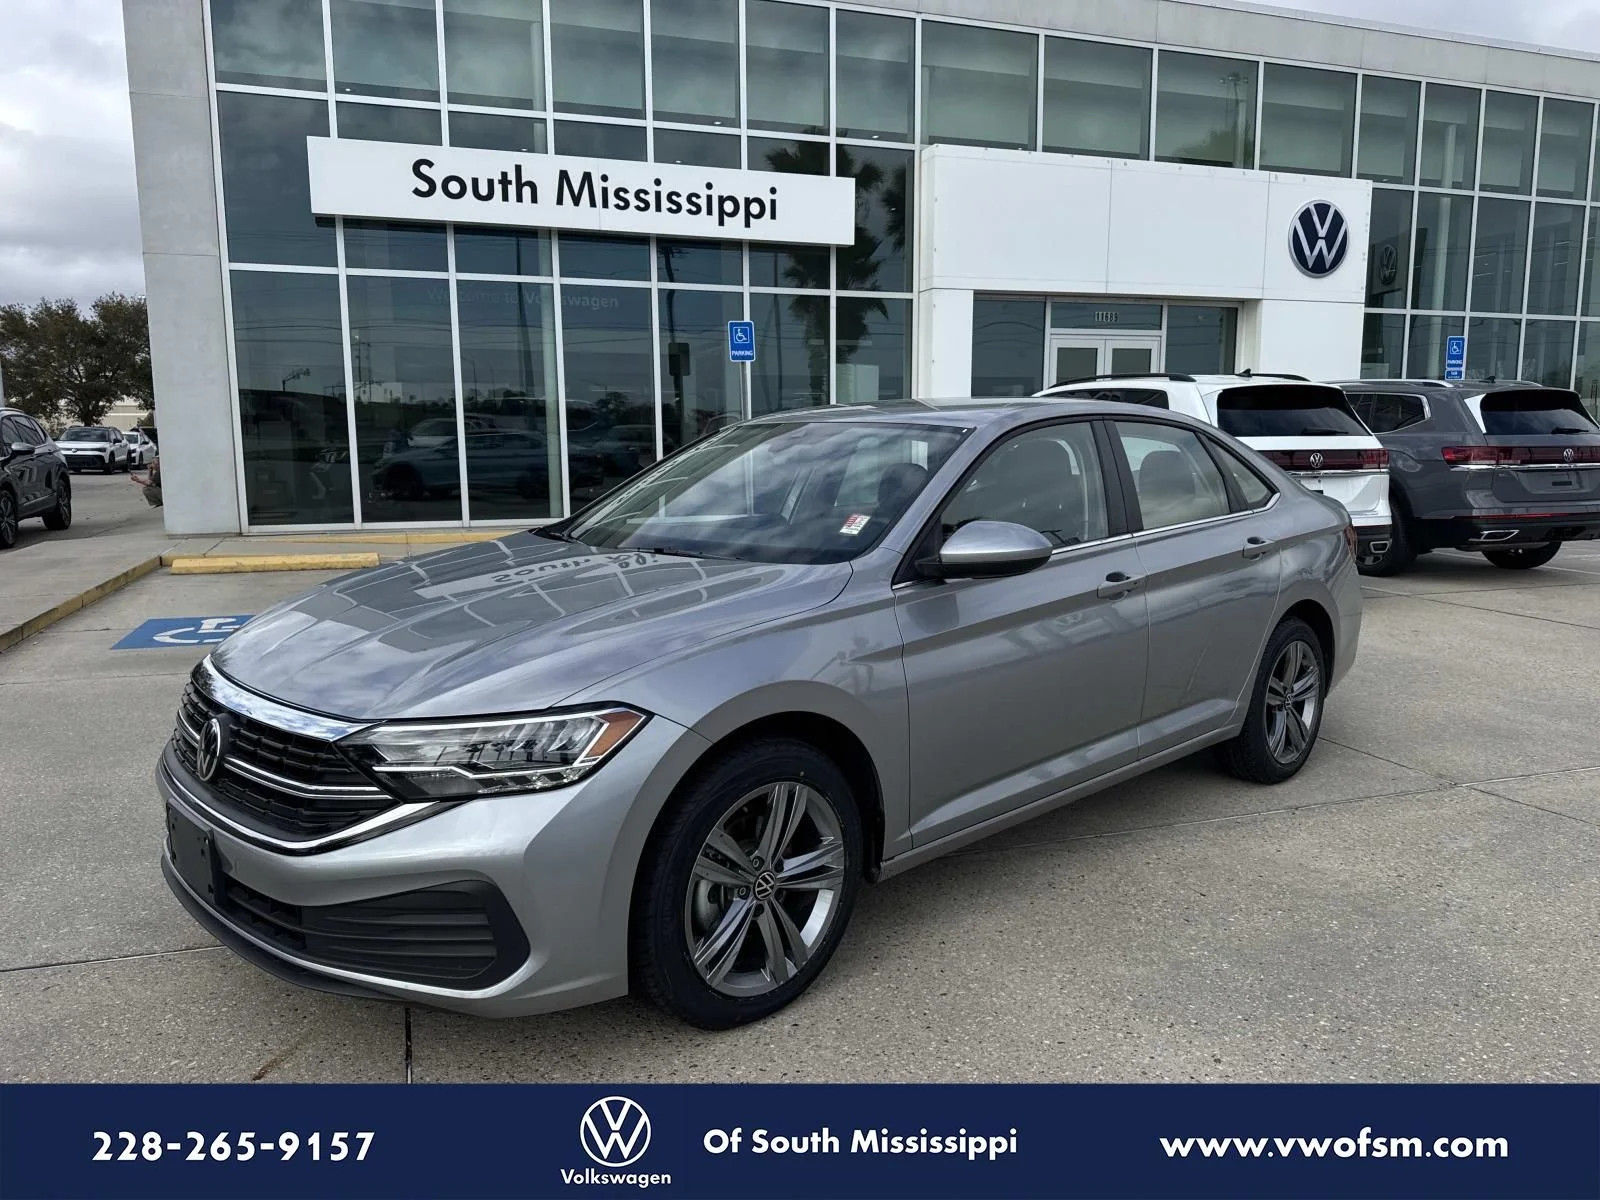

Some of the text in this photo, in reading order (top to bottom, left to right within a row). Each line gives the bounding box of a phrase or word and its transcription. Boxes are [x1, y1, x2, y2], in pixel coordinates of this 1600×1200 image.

[412, 158, 777, 228] South Mississippi
[1288, 199, 1350, 279] VW
[524, 290, 619, 310] Voswagen
